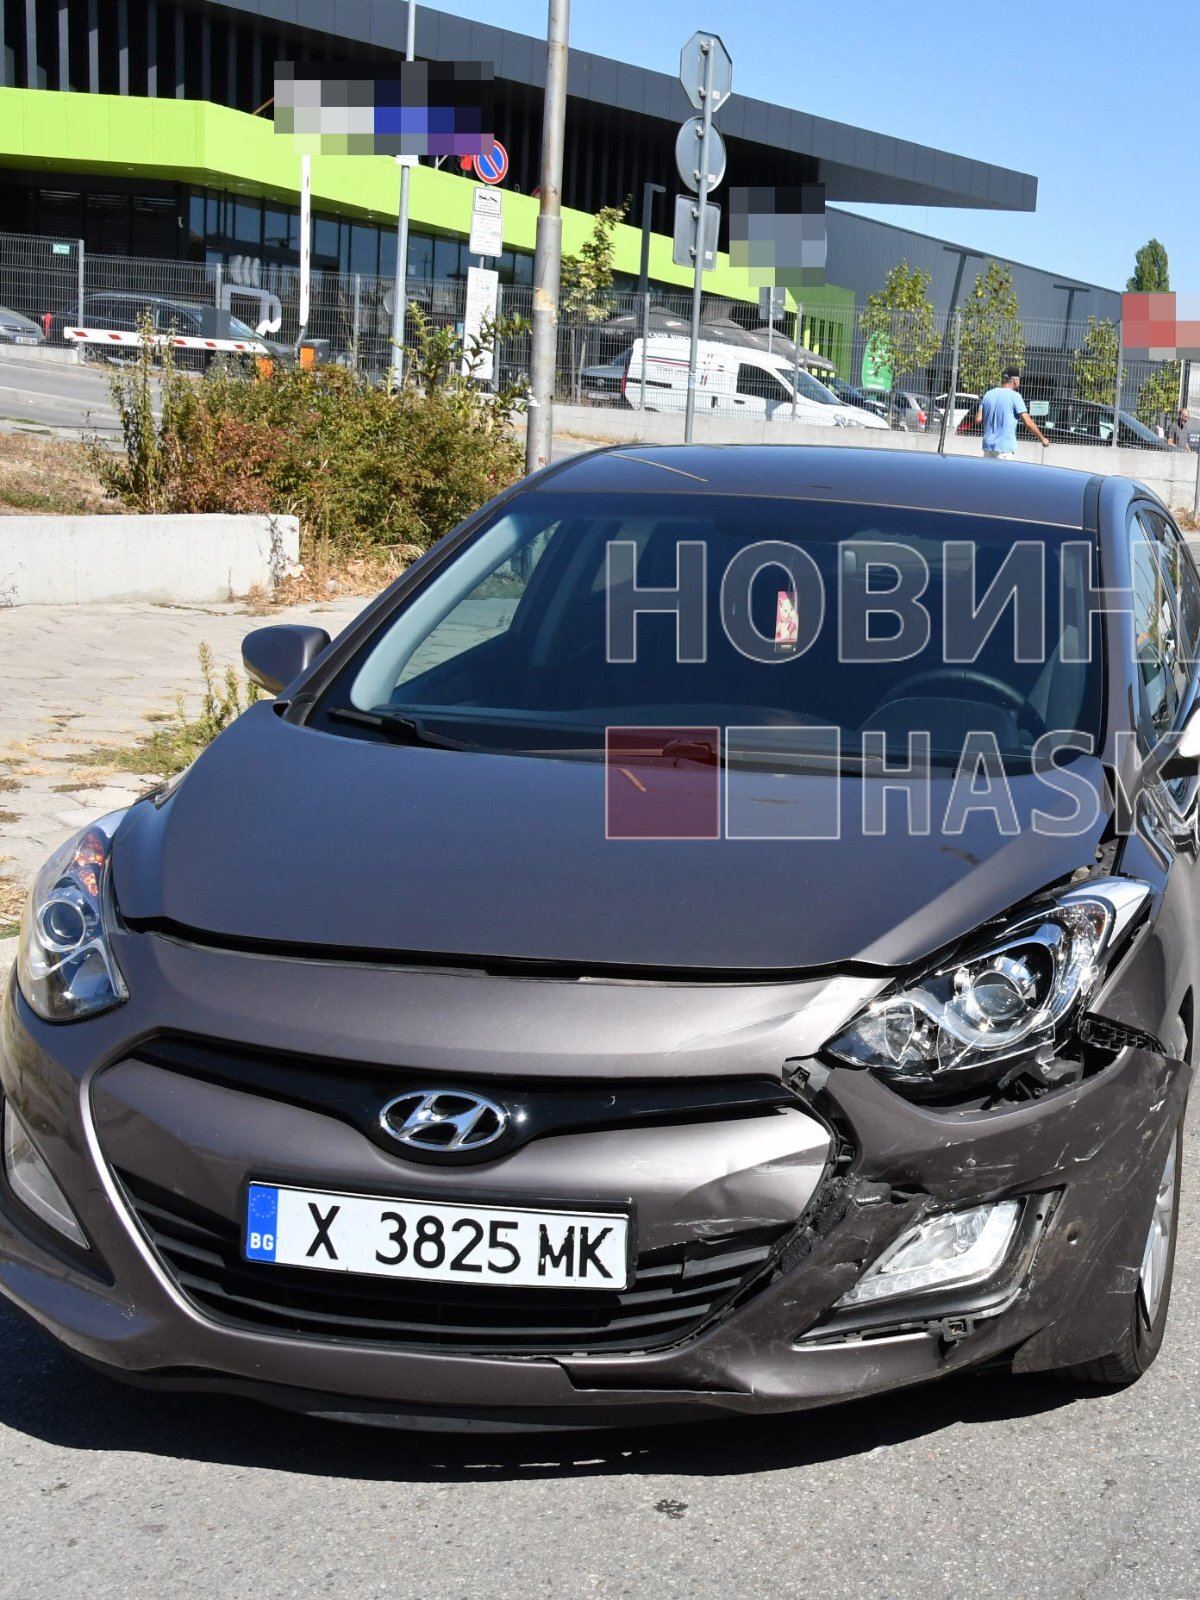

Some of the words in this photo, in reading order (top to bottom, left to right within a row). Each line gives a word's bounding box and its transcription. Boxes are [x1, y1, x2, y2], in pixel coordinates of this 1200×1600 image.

[250, 1231, 275, 1252] BG
[304, 1202, 341, 1261] X
[374, 1210, 522, 1275] 3825
[536, 1222, 614, 1280] MK
